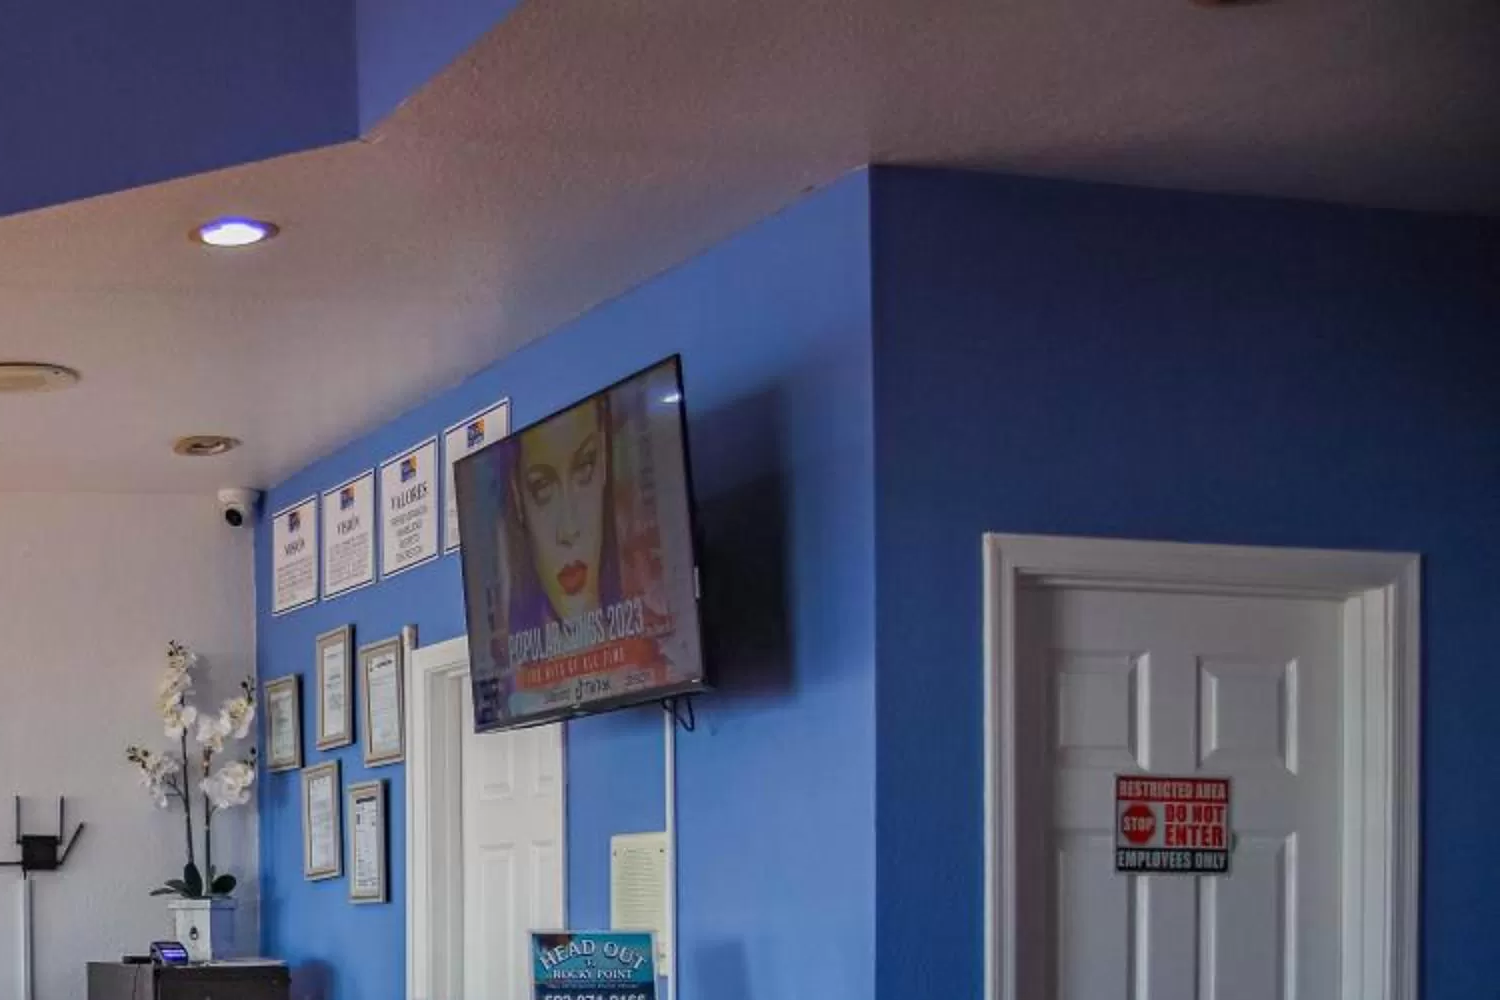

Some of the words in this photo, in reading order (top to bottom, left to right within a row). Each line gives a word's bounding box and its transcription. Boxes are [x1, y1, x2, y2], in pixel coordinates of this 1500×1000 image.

[509, 622, 561, 667] POPULAR
[607, 597, 644, 640] 2023
[1119, 780, 1193, 798] RESTRICTED
[1195, 782, 1226, 800] AREA
[1123, 815, 1155, 831] STOP
[1165, 803, 1187, 823] DO
[1192, 804, 1225, 823] NOT
[1165, 824, 1224, 847] ENTER
[1119, 851, 1192, 869] EMPLOYEES
[1195, 852, 1226, 869] ONLY
[540, 939, 597, 970] HEAD
[603, 941, 647, 969] OUT
[553, 969, 593, 979] ROCKY
[597, 969, 632, 979] POINT
